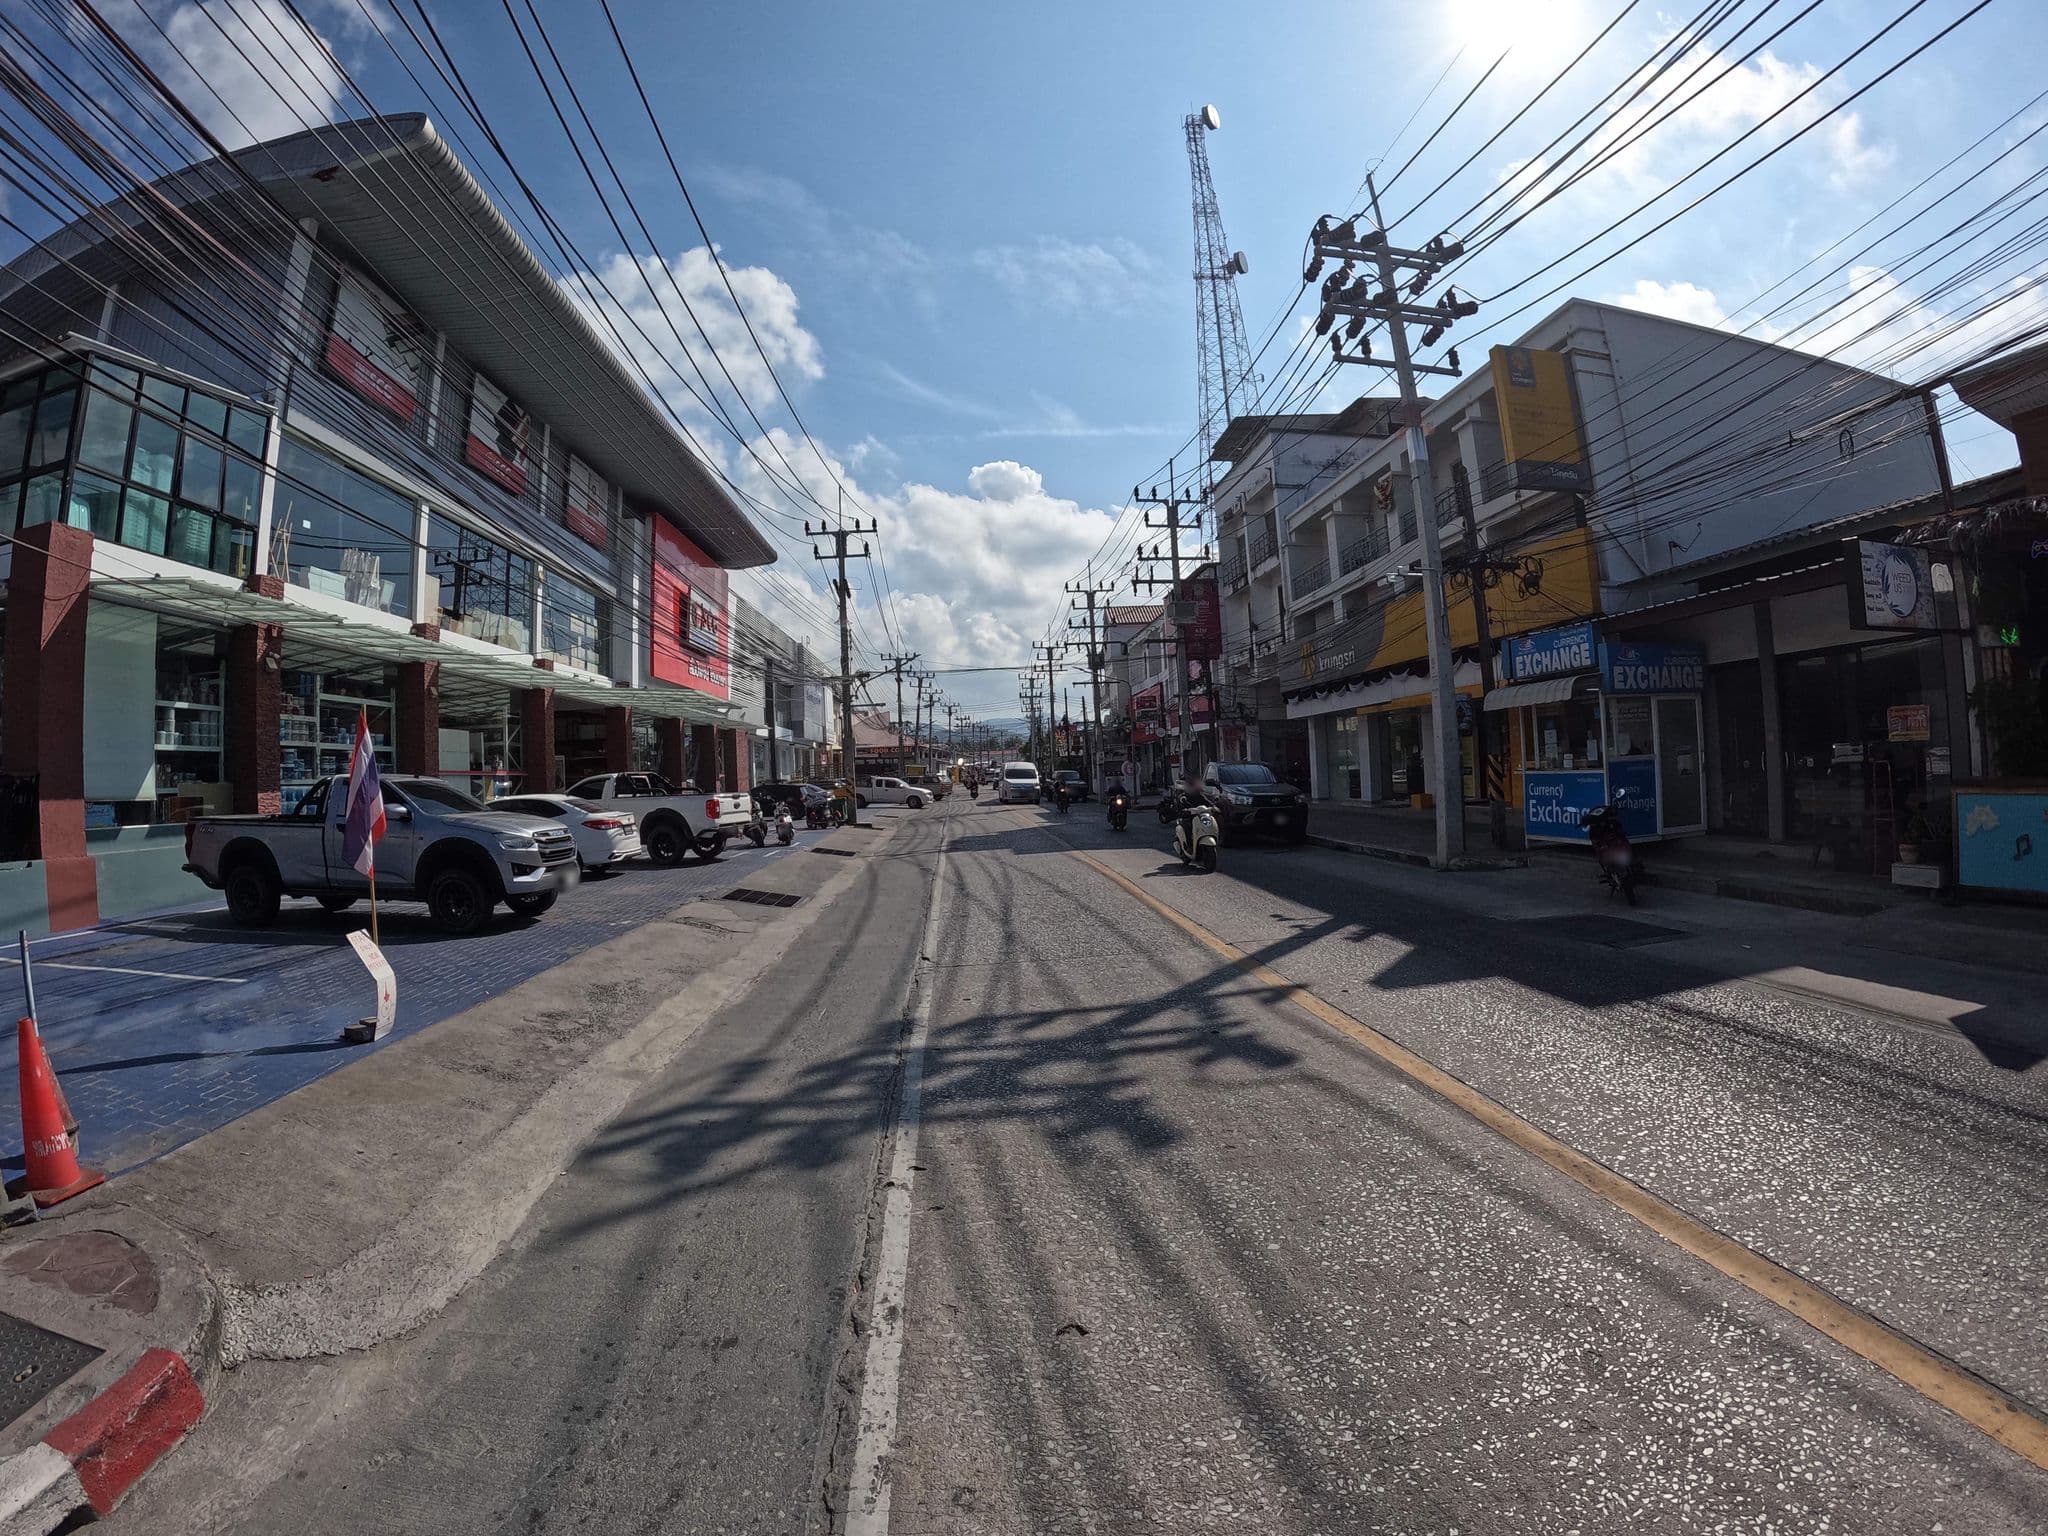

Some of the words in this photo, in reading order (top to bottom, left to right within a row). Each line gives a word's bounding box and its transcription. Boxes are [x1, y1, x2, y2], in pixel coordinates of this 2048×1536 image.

[1553, 633, 1589, 649] CURRENCY
[1319, 645, 1356, 671] krungsri
[1515, 643, 1591, 678] EXCHANGE
[1613, 665, 1704, 689] EXCHANGE
[1528, 783, 1564, 800] Currency
